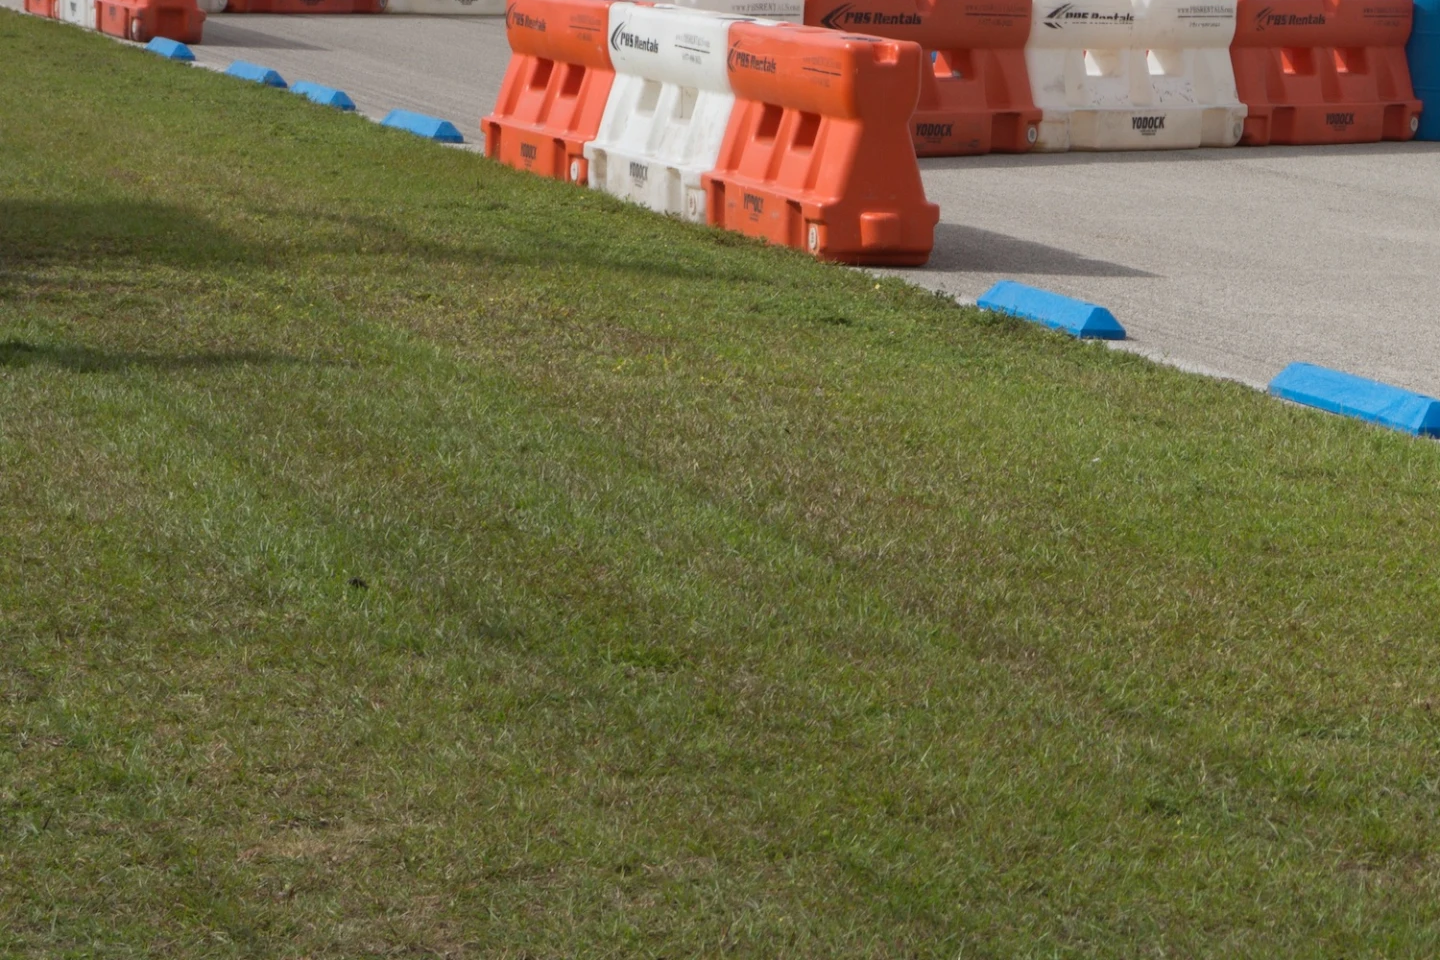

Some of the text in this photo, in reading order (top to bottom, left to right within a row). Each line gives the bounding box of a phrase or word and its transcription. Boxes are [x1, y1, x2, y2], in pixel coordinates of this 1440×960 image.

[525, 14, 547, 33] Rentals
[843, 10, 922, 26] PBS Rentals
[1266, 13, 1326, 26] PBS Rentals
[620, 30, 634, 47] PBS
[634, 34, 659, 54] Rentals
[751, 54, 777, 74] Rentals
[915, 123, 953, 137] YODOCK
[1132, 115, 1165, 130] YODOCK
[630, 161, 649, 180] YODOCK
